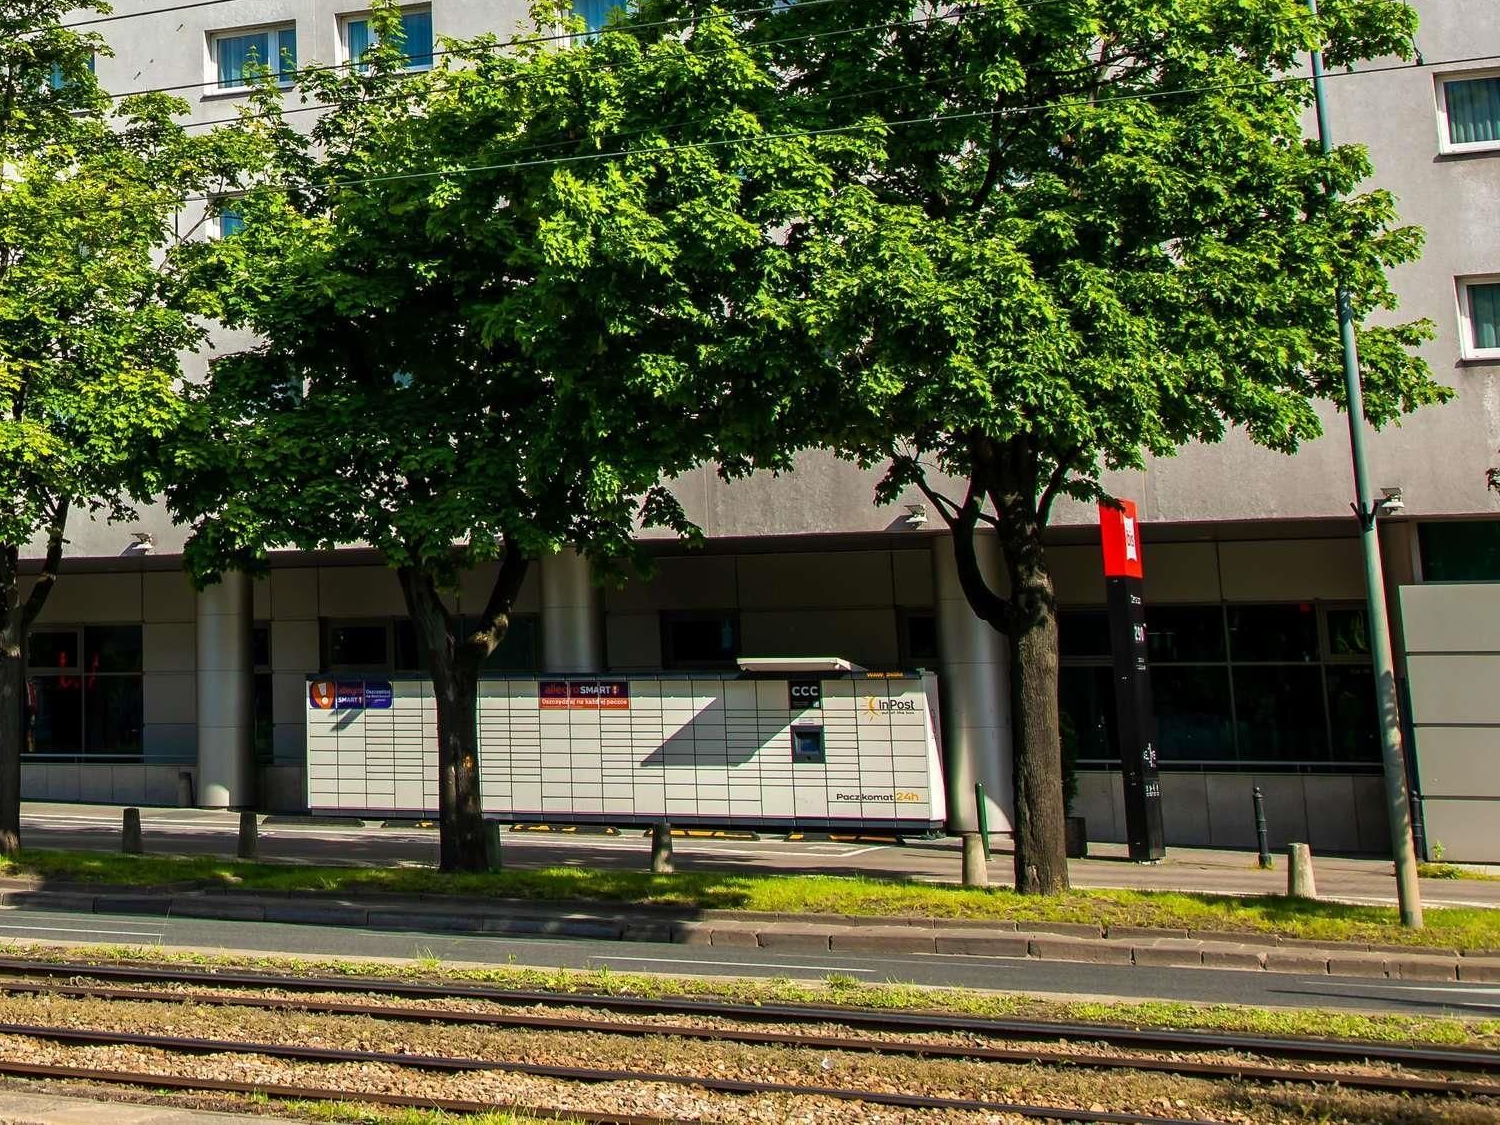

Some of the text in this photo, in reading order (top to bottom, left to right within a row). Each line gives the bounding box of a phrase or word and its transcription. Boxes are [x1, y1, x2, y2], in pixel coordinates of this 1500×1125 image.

[791, 686, 819, 696] CCC
[878, 699, 915, 711] InPost
[836, 792, 919, 801] Paczkomat 24h
